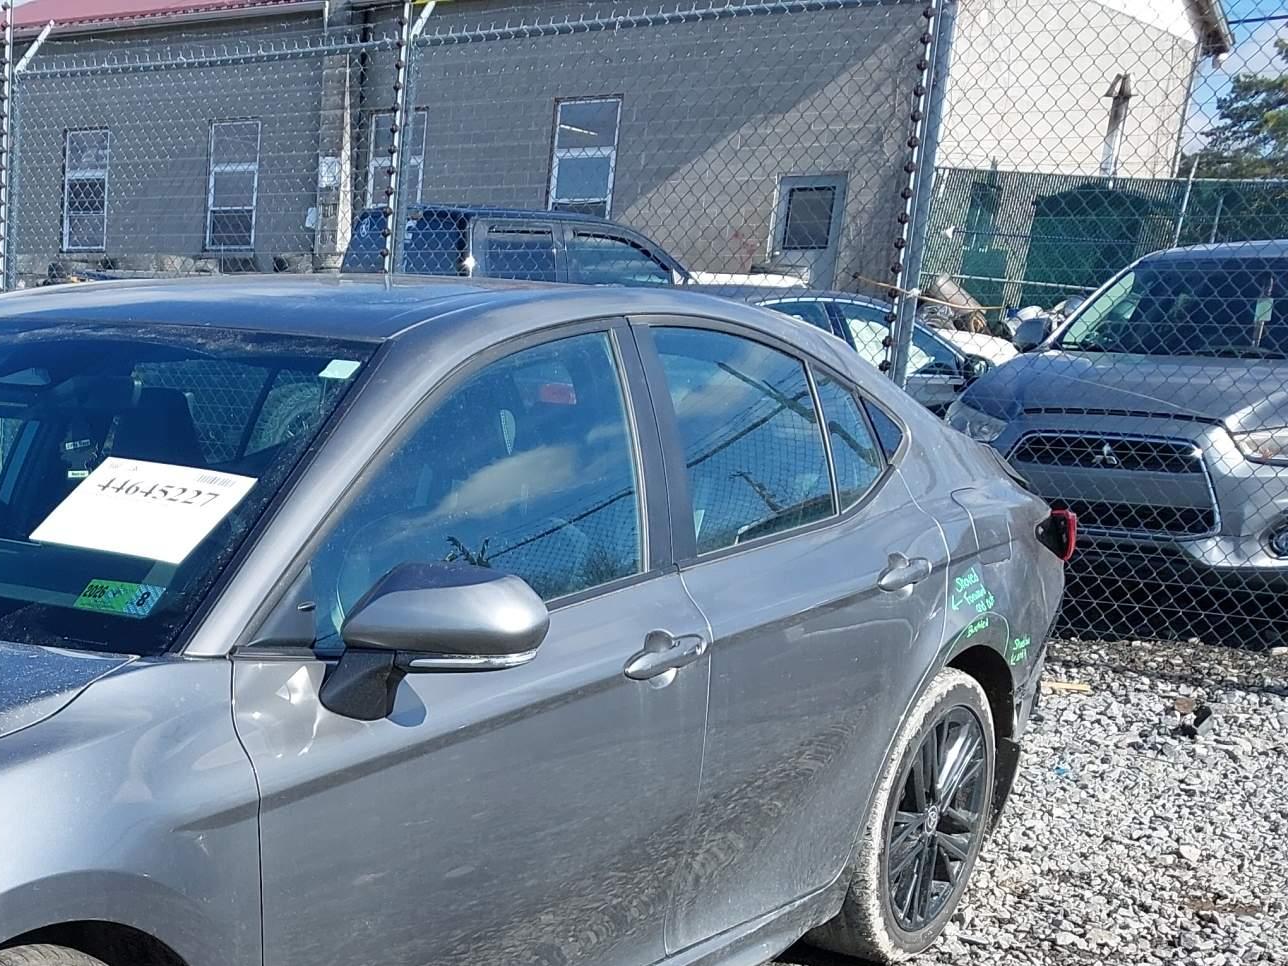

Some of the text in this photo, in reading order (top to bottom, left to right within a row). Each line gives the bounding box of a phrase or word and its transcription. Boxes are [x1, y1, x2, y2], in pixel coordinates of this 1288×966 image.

[97, 477, 221, 507] 44645227
[82, 584, 151, 607] 2026 8
